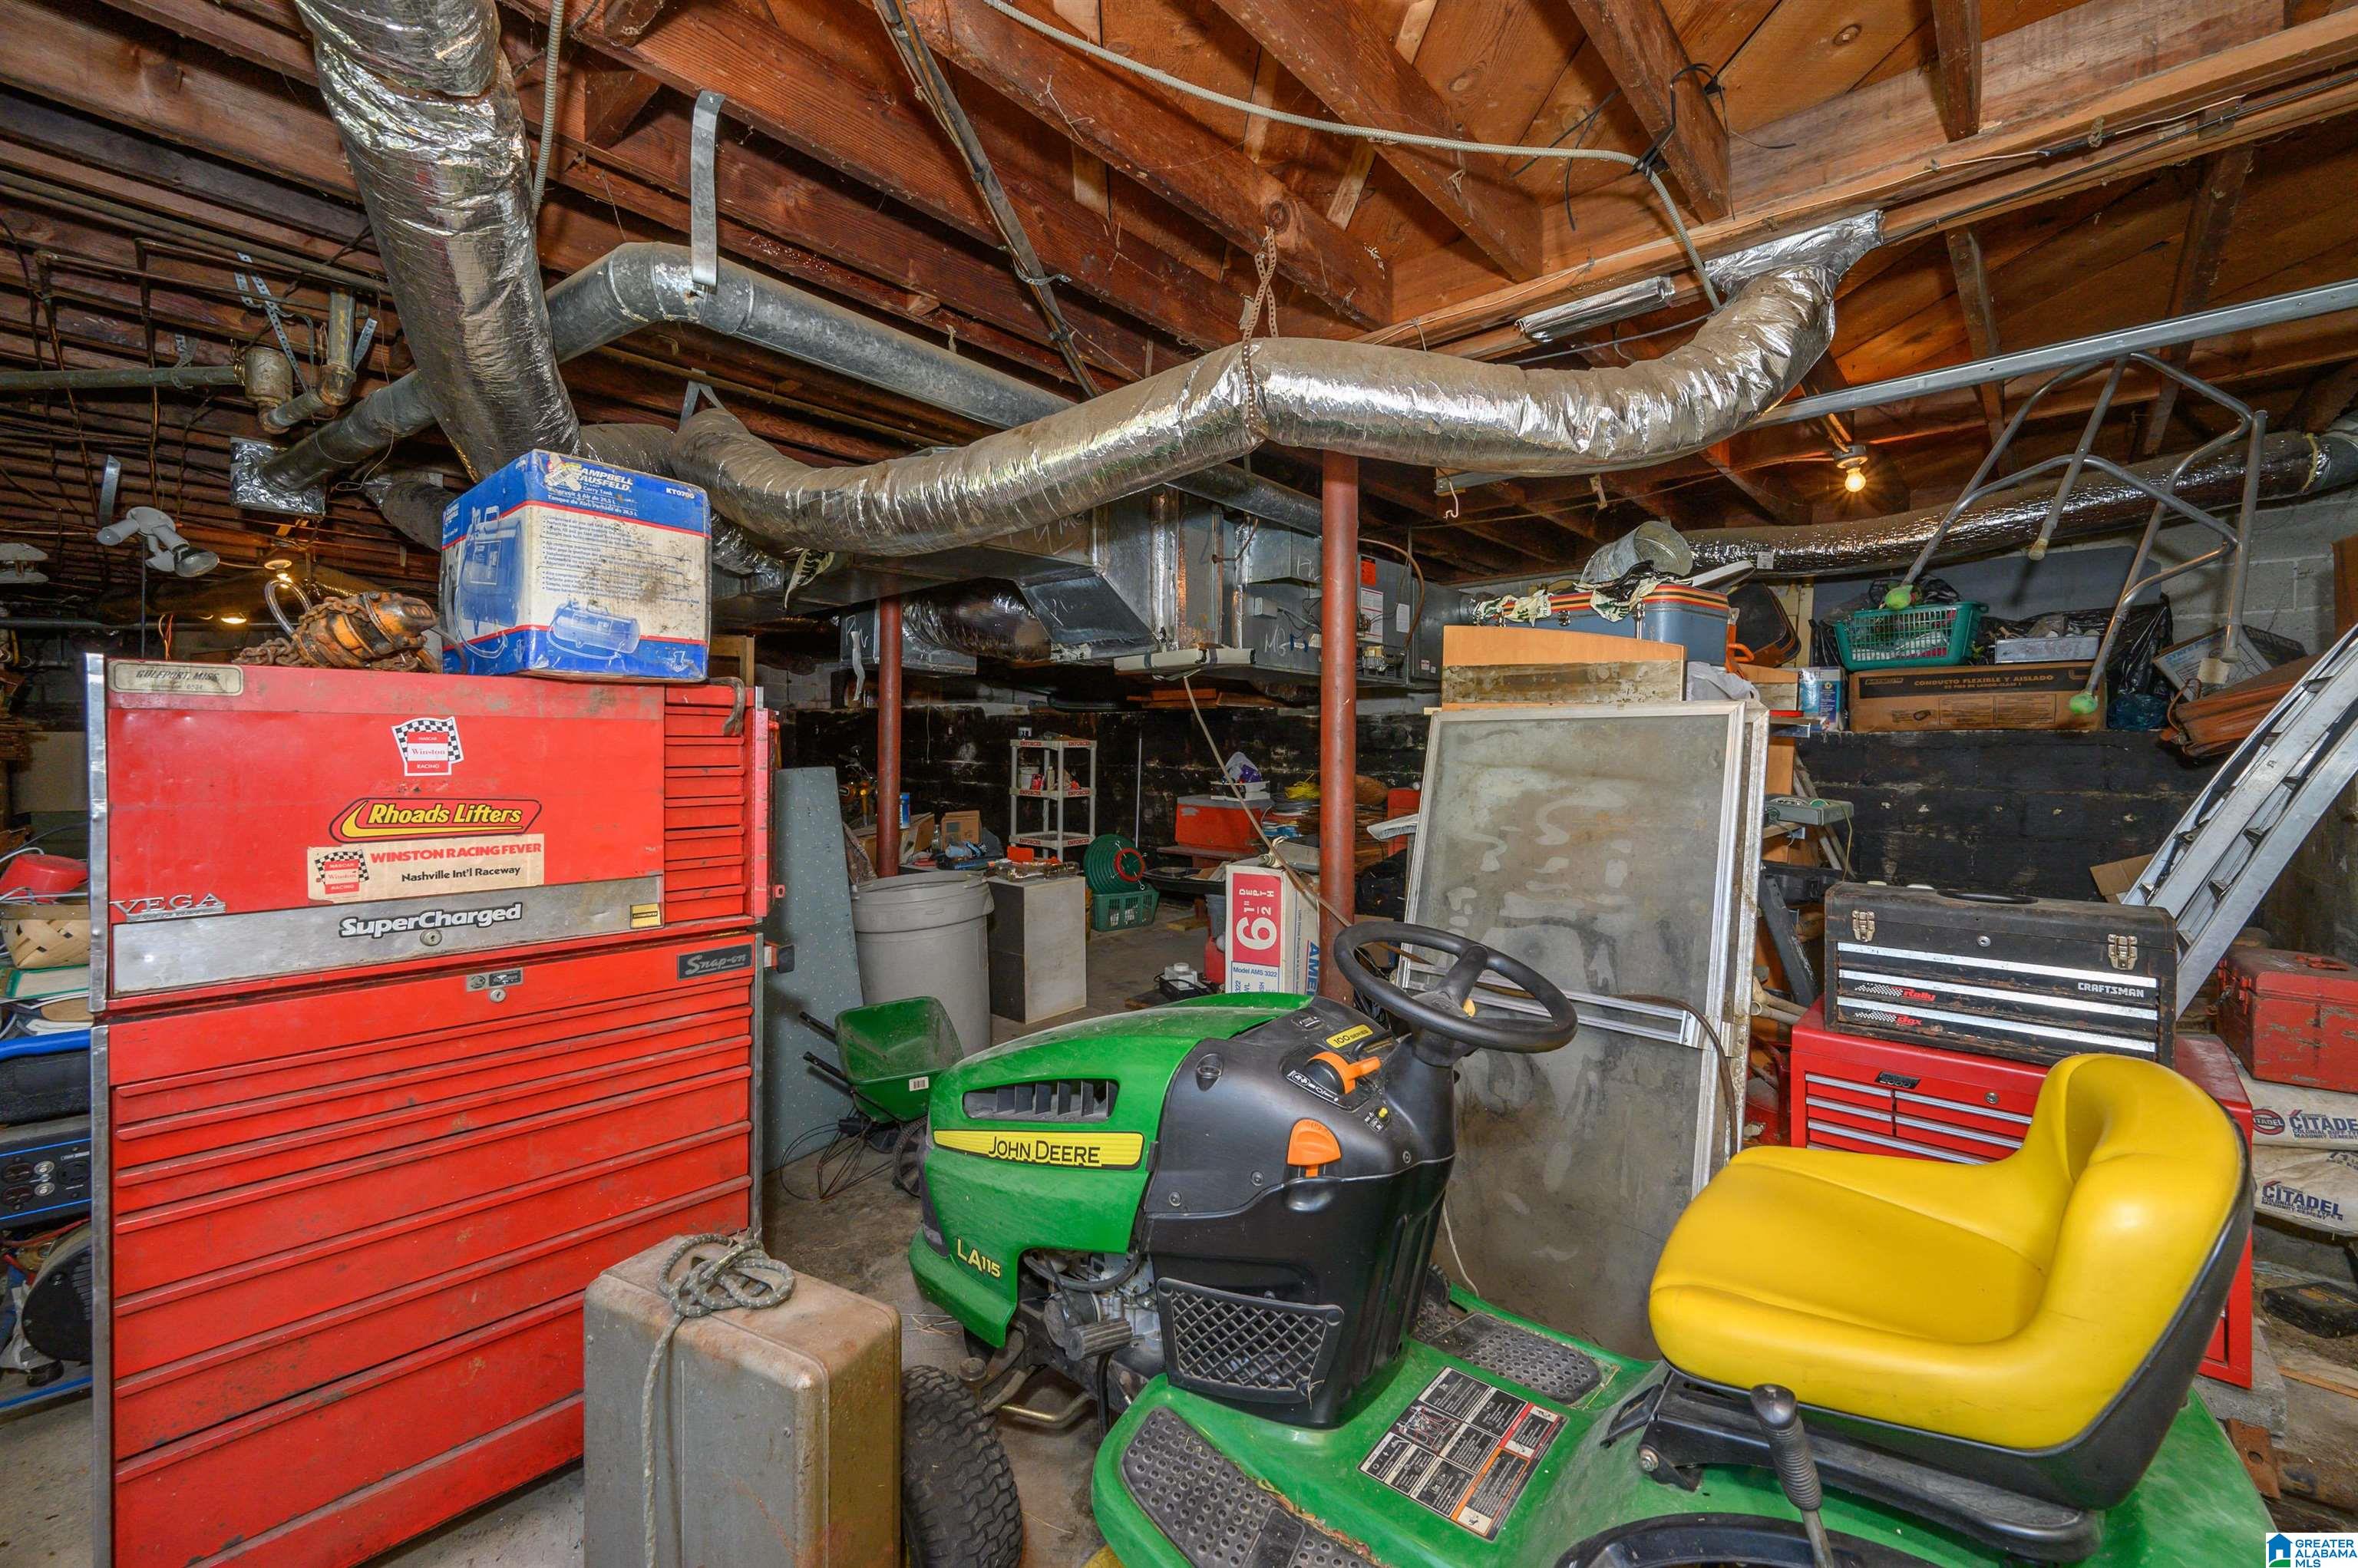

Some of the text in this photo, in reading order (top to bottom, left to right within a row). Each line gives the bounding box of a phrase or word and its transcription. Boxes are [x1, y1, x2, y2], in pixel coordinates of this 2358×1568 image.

[580, 467, 633, 485] AMPBELL
[580, 475, 630, 491] AUSFELD
[367, 803, 522, 824] Rhoads Lifters
[370, 843, 542, 863] WINSTON RACING FEVER
[401, 866, 521, 883] Nashville Int'l Raceway
[109, 893, 225, 914] VEGA
[1239, 889, 1275, 898] DEPTH
[340, 903, 523, 939] SuperCharged
[1236, 916, 1277, 950] 6
[685, 952, 747, 975] Snap-on
[1233, 966, 1250, 975] Model
[1903, 989, 1936, 1002] Rally
[2077, 982, 2145, 998] CRAFTSMAN
[1333, 1035, 1351, 1045] 100
[989, 1136, 1101, 1164] JOHN DEERE
[2261, 1185, 2344, 1216] CITADEL
[2261, 1196, 2295, 1209] COLONIAL
[2261, 1200, 2327, 1220] MASONRY CEMENT
[957, 1237, 1001, 1278] LA115
